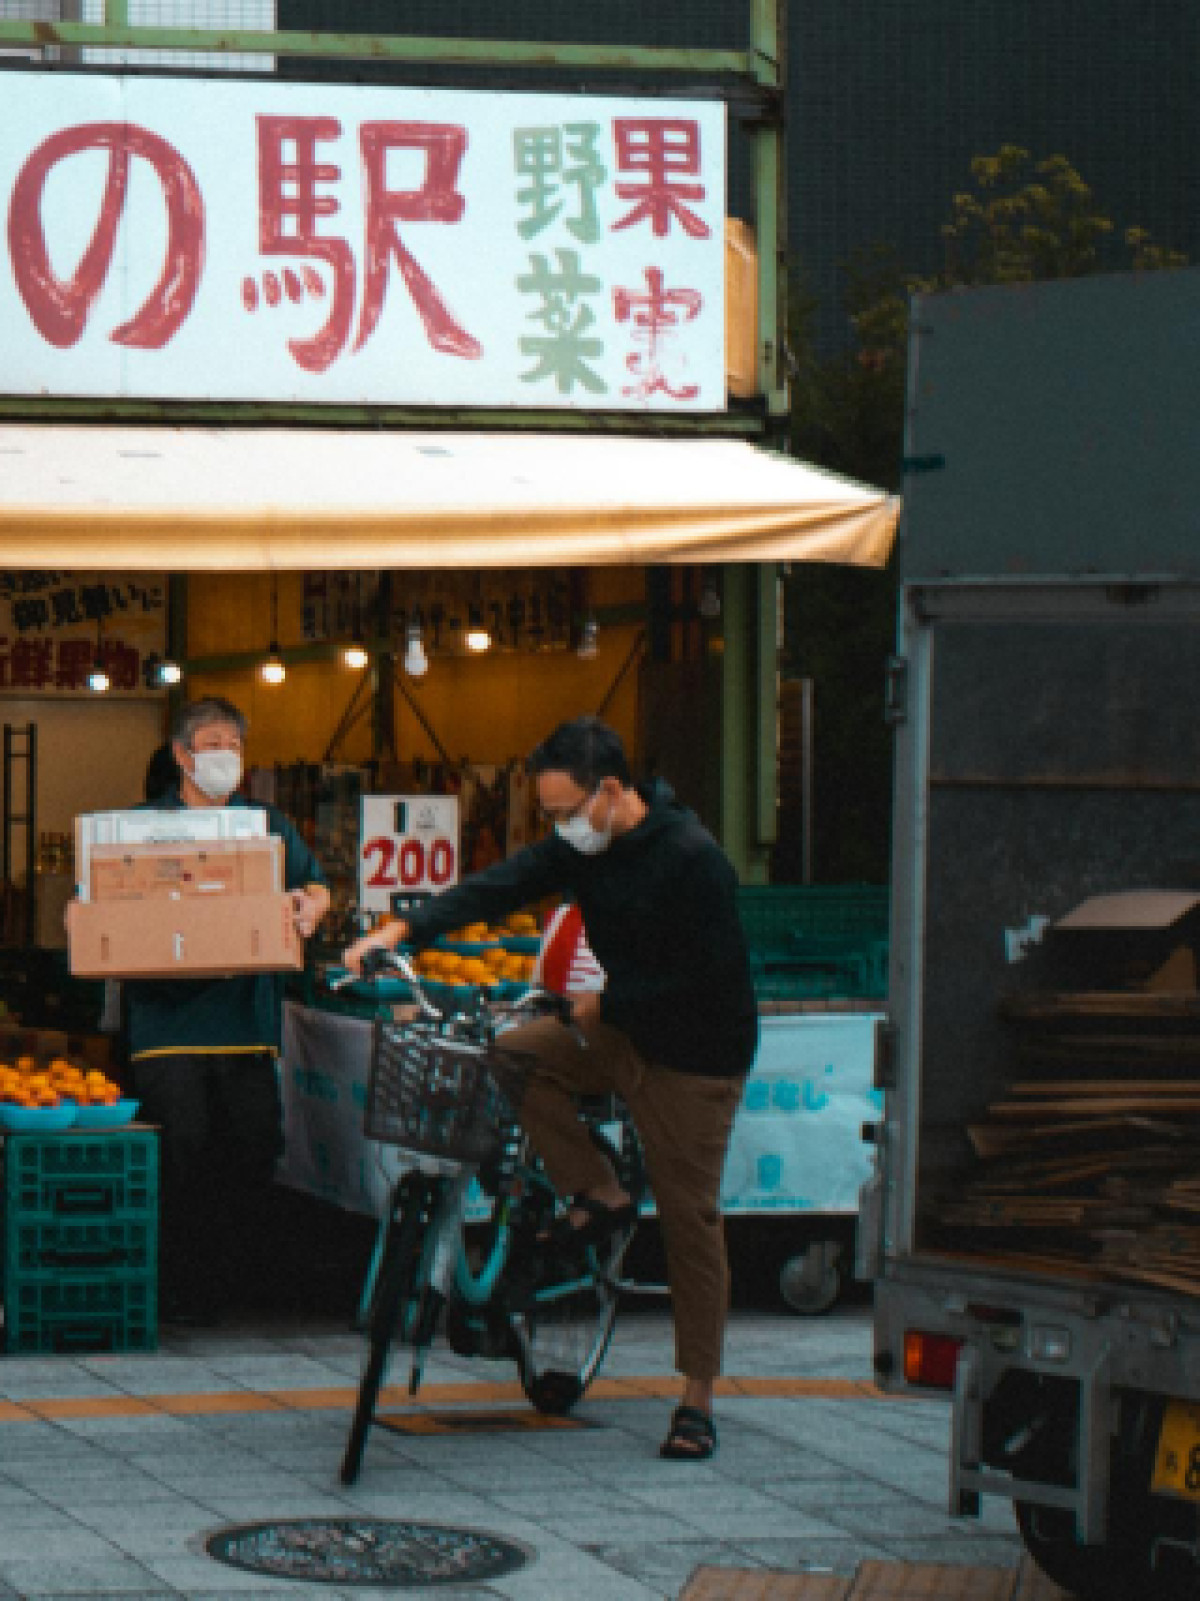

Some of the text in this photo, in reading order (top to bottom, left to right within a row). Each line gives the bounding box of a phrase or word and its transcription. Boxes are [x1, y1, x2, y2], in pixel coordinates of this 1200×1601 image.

[511, 122, 608, 395] 野菜
[611, 117, 711, 401] 果実
[362, 836, 455, 888] 200
[745, 1079, 829, 1111] まなし
